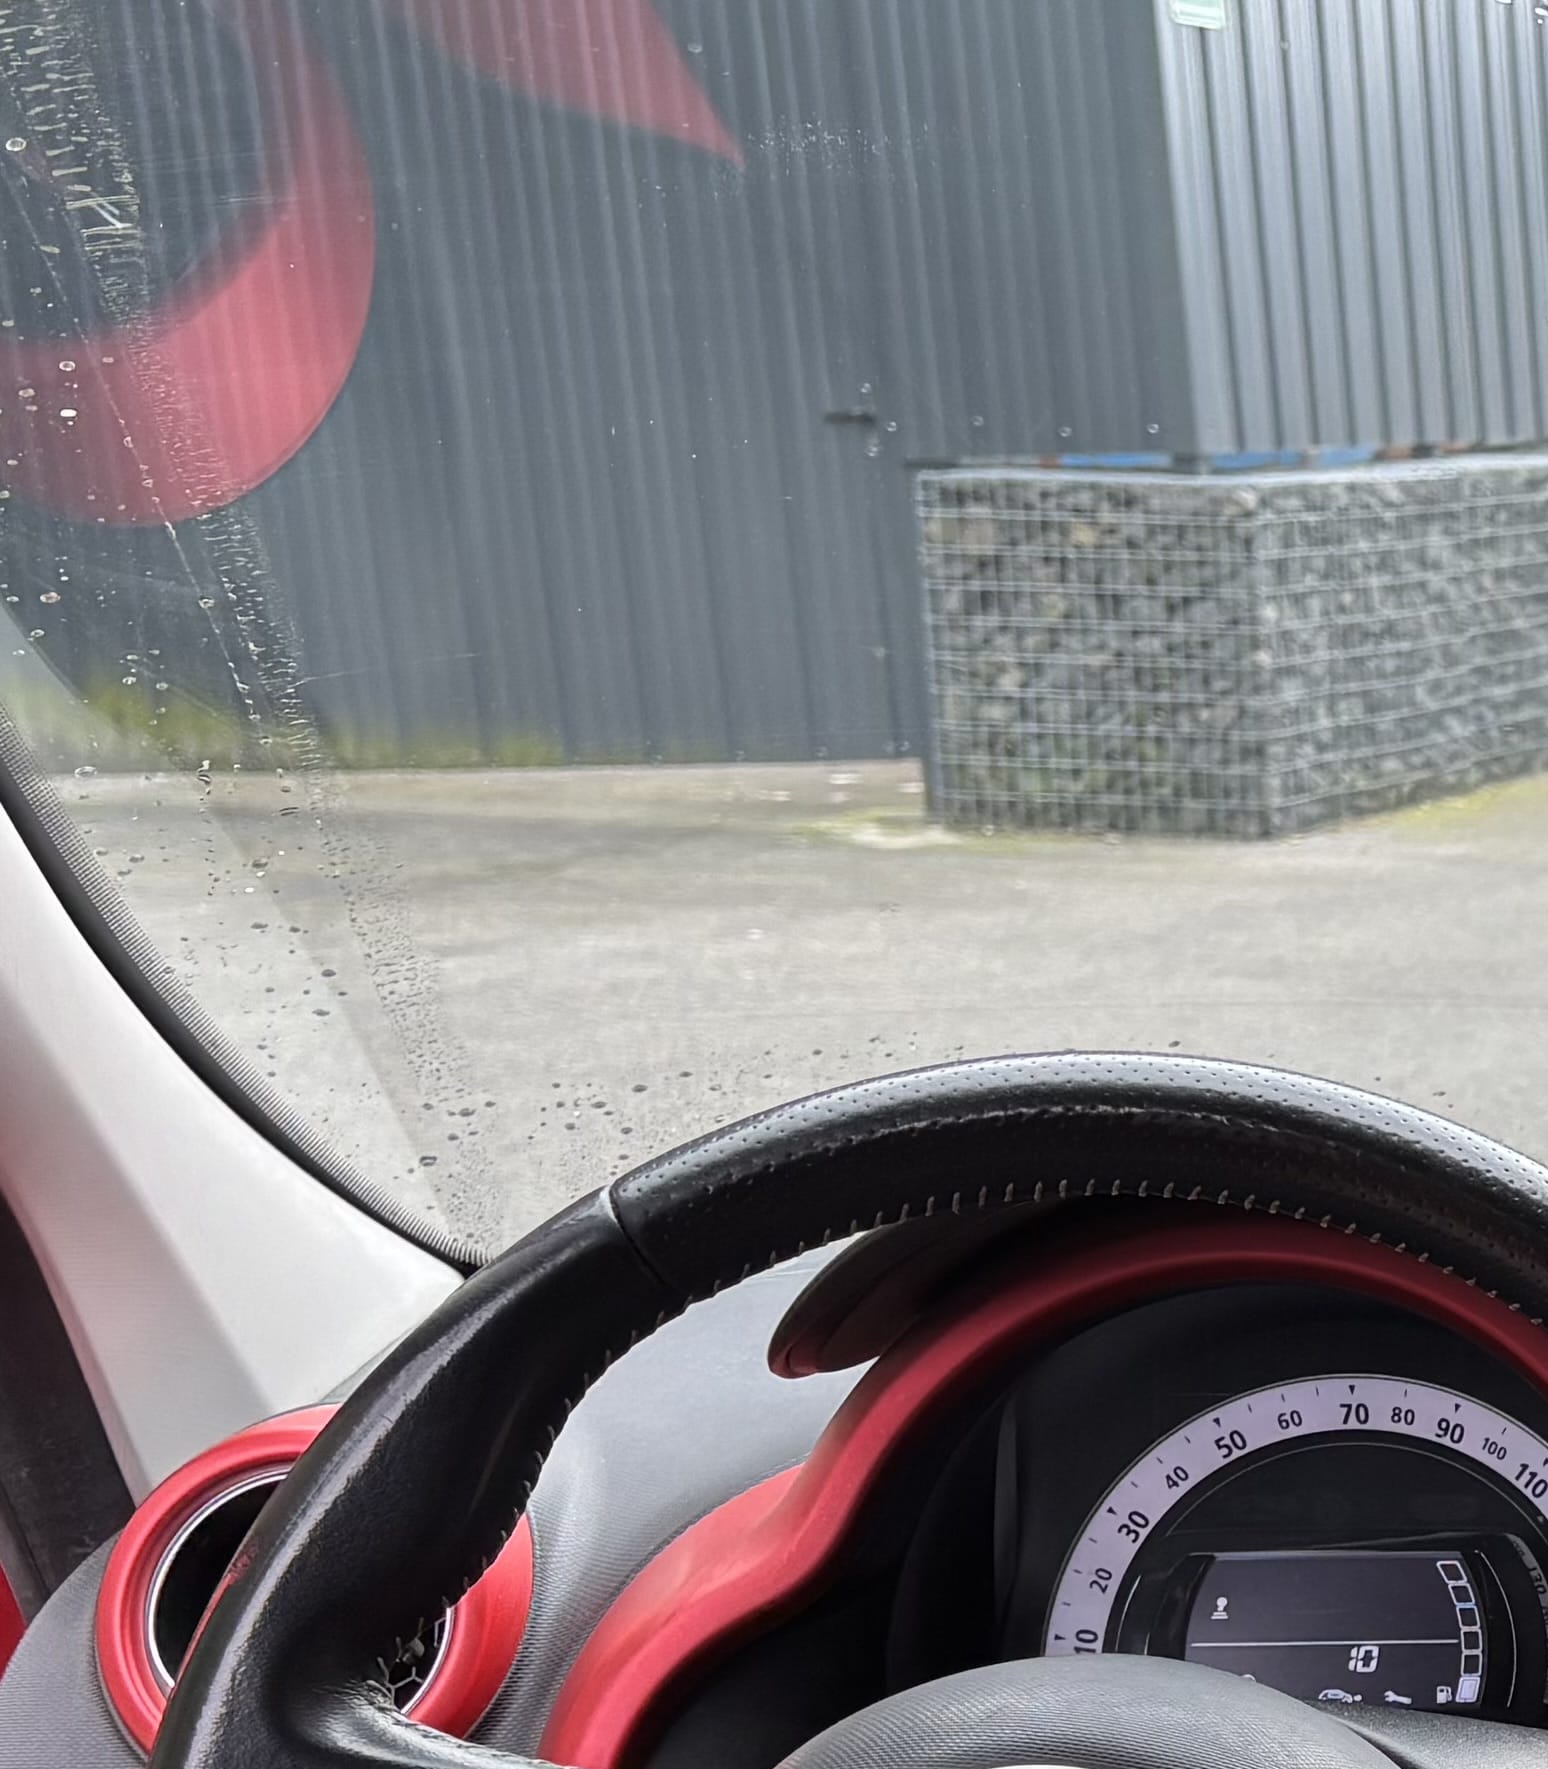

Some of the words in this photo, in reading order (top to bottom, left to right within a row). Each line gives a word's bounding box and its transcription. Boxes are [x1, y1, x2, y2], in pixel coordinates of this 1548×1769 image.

[1089, 1567, 1113, 1594] 20
[1117, 1510, 1150, 1543] 30
[1163, 1465, 1190, 1491] 40
[1214, 1429, 1248, 1459] 50
[1276, 1409, 1303, 1431] 60
[1339, 1402, 1370, 1425] 70
[1390, 1406, 1416, 1427] 80
[1434, 1417, 1466, 1445] 90
[1480, 1436, 1508, 1461] 100
[1513, 1462, 1548, 1499] 110
[1348, 1645, 1380, 1673] 10
